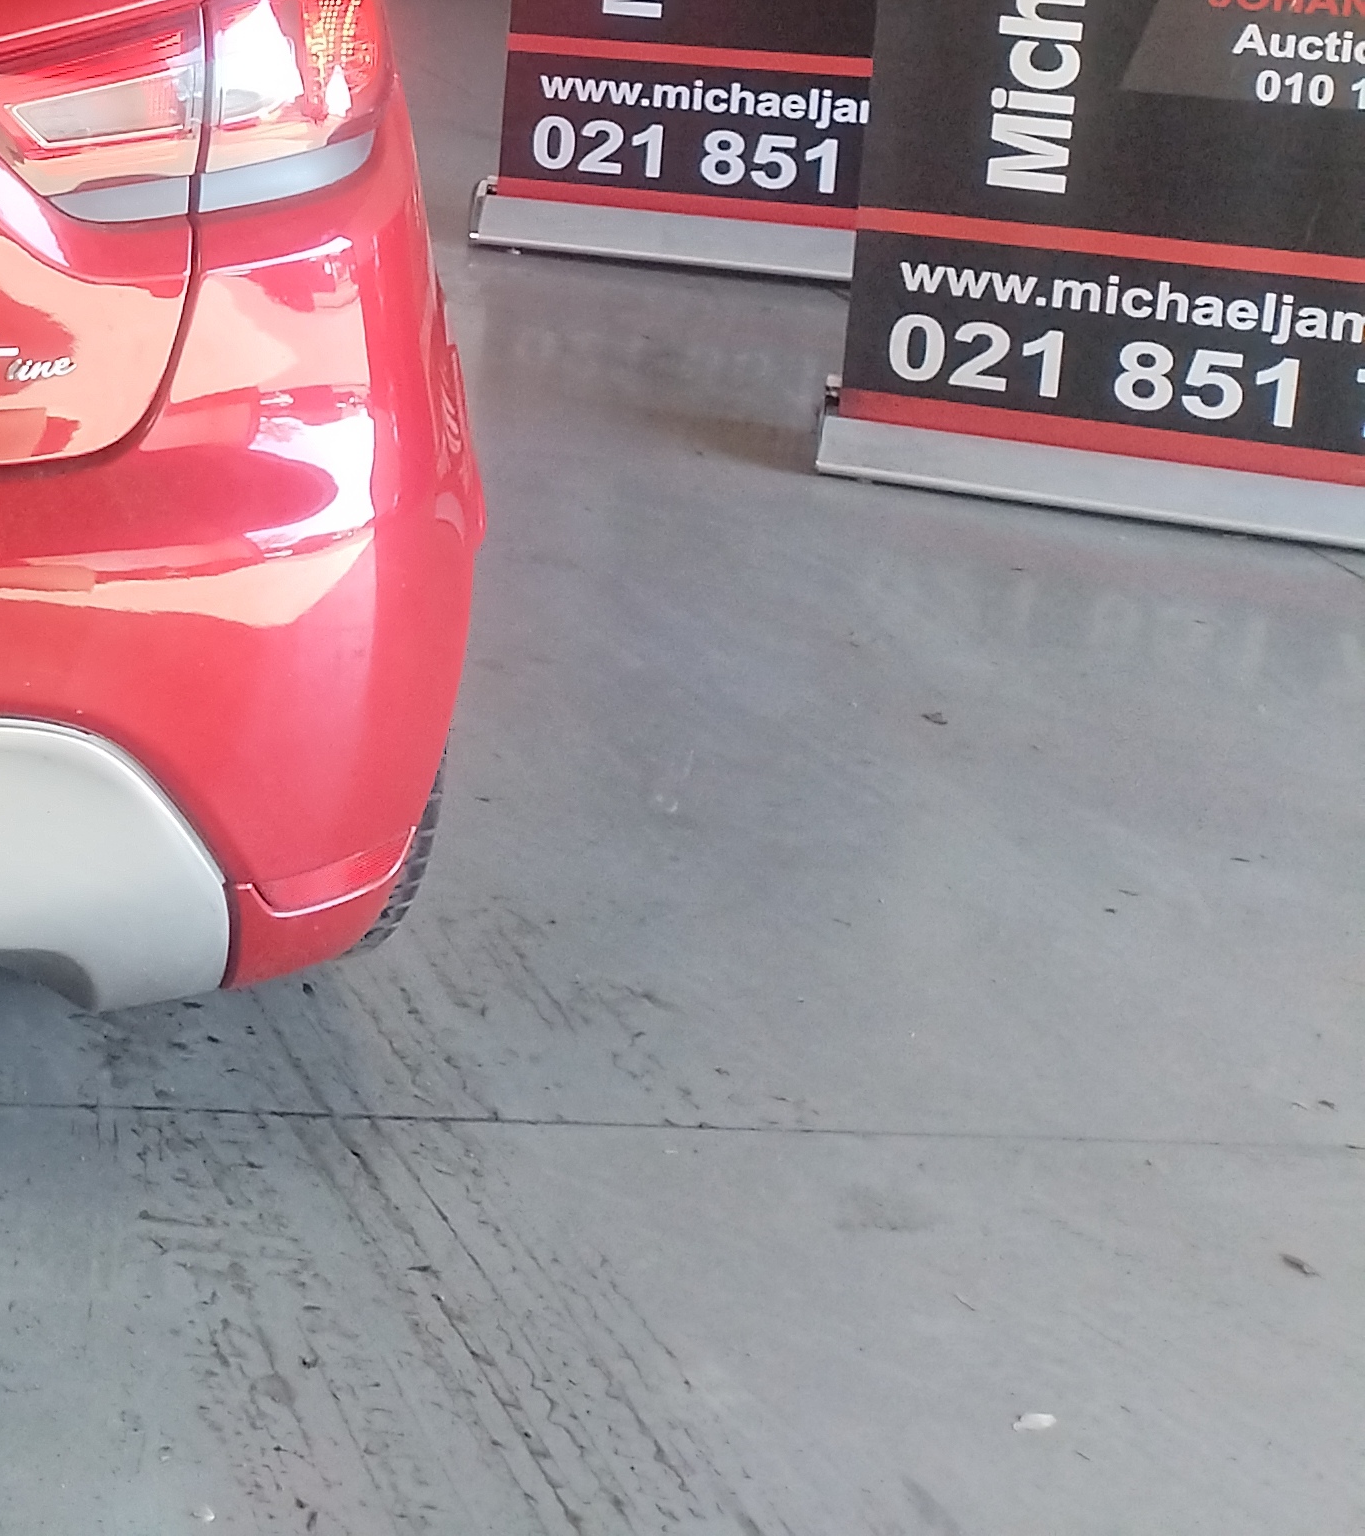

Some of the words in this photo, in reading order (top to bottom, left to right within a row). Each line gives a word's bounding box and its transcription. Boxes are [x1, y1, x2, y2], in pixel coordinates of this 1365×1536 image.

[1256, 70, 1334, 106] 010
[534, 116, 663, 177] 021
[701, 130, 838, 193] 851
[889, 314, 1063, 397] 021
[1114, 342, 1299, 428] 851
